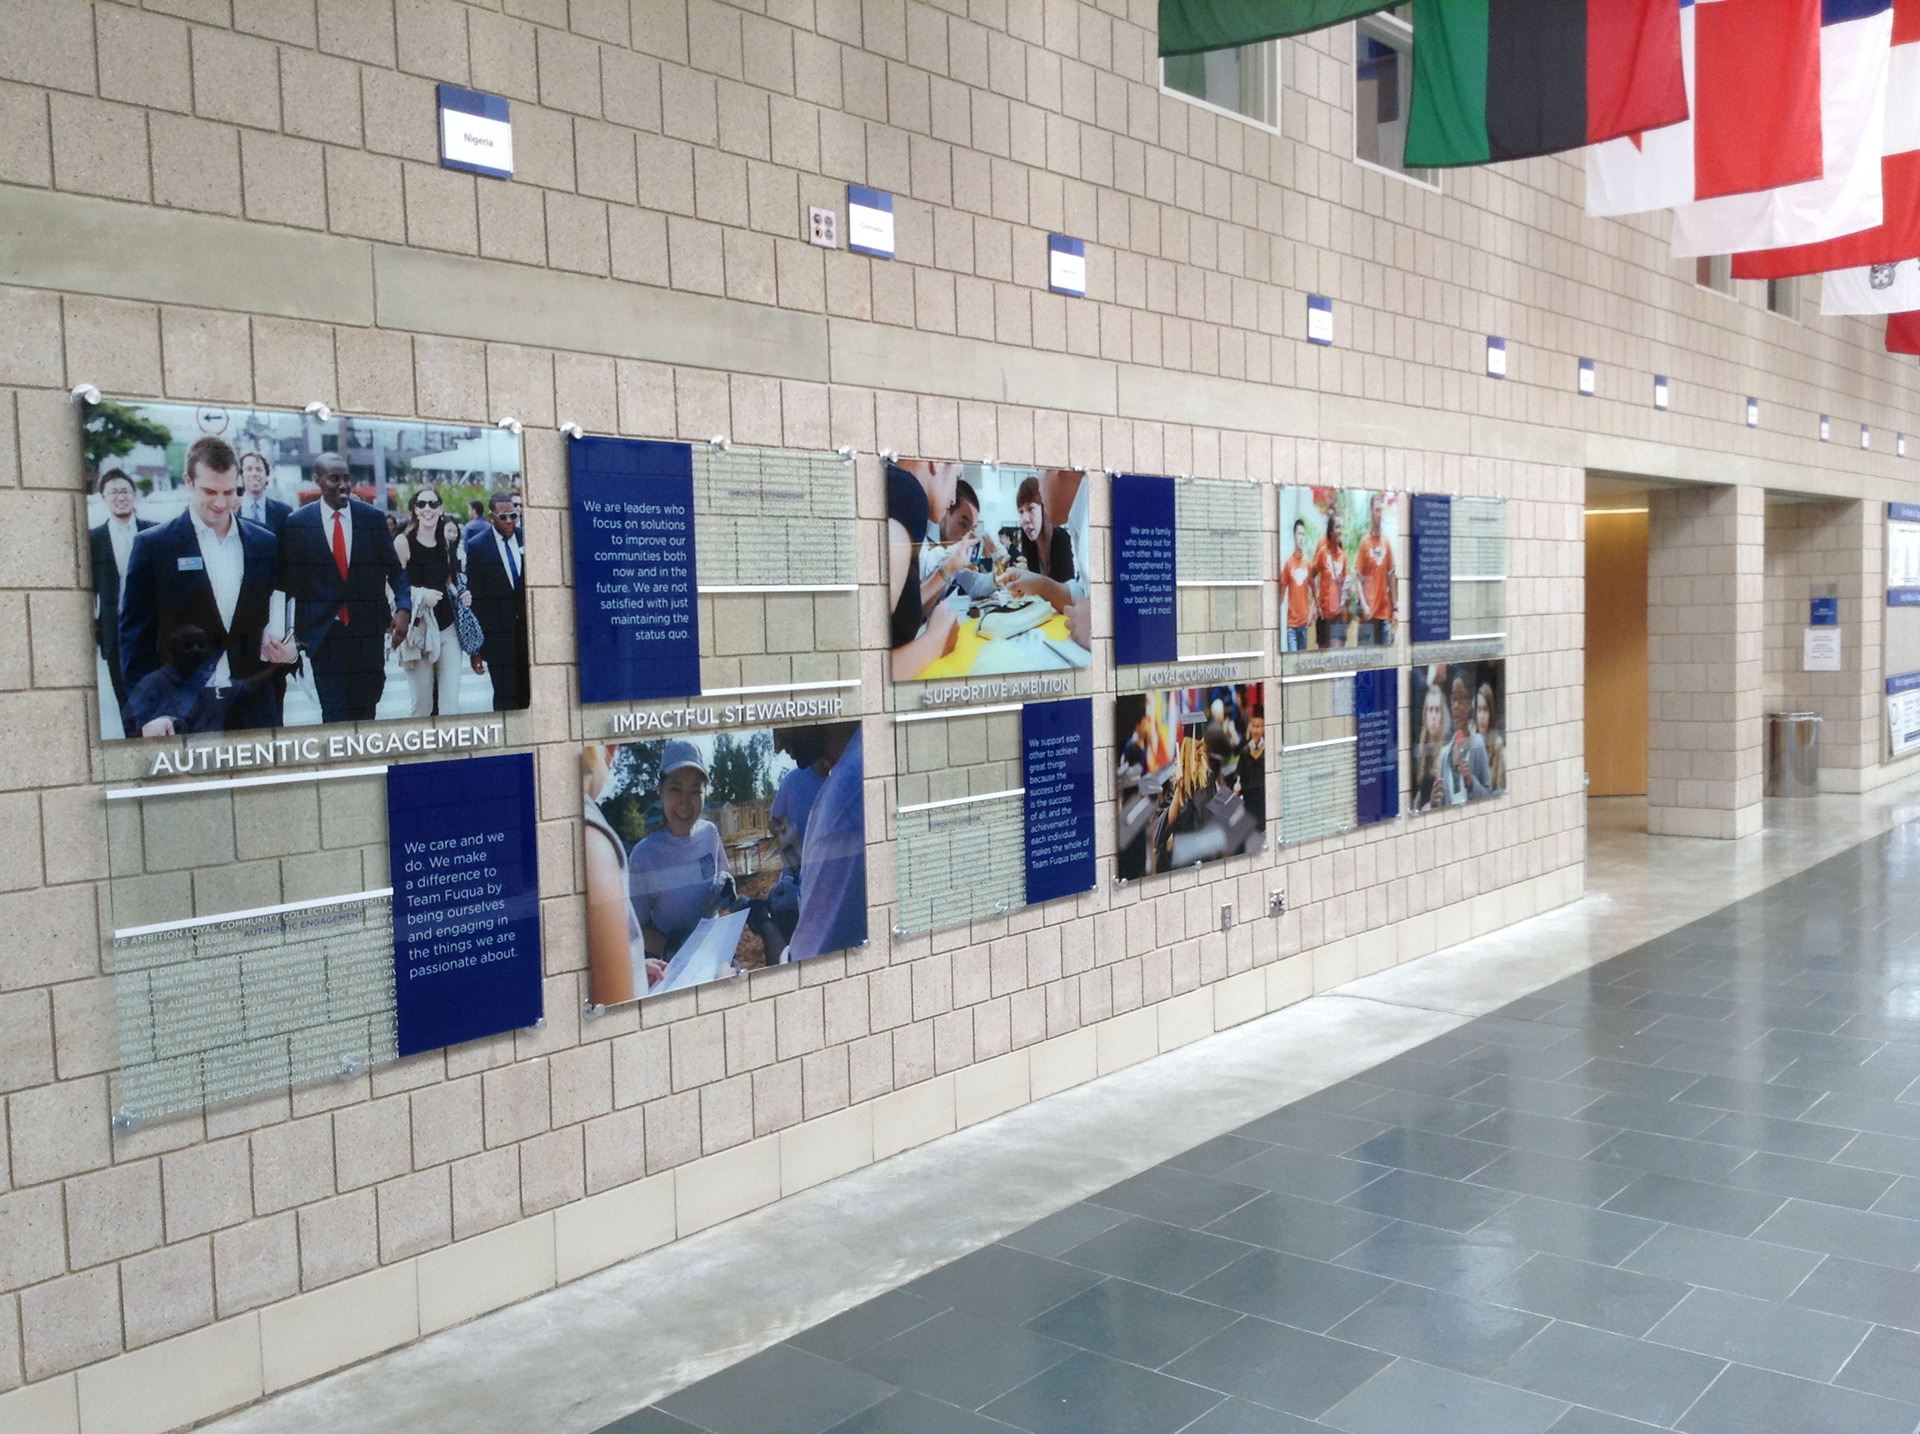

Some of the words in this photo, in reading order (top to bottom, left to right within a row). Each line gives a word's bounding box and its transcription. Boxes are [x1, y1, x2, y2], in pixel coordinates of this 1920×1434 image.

[463, 133, 494, 147] Nigeria
[584, 501, 601, 512] We
[604, 503, 620, 513] are
[624, 502, 660, 514] leaders
[664, 504, 684, 515] who
[593, 517, 622, 528] focus
[625, 519, 638, 529] on
[641, 518, 685, 530] solutions
[612, 535, 622, 544] to
[626, 535, 666, 546] improve
[670, 537, 685, 545] our
[595, 551, 661, 561] communities
[664, 551, 686, 561] both
[613, 568, 634, 577] now
[638, 566, 656, 576] and
[660, 567, 668, 576] in
[671, 567, 687, 576] the
[597, 582, 630, 593] future.
[633, 582, 649, 592] We
[653, 584, 668, 592] are
[671, 583, 687, 592] not
[601, 598, 643, 609] satisfied
[646, 598, 668, 608] with
[670, 598, 688, 610] just
[611, 615, 670, 625] maintaining
[673, 614, 689, 624] the
[636, 630, 665, 640] status
[668, 630, 689, 640] quo.
[1148, 670, 1179, 684] LOYAL
[1184, 665, 1238, 681] COMMUNITY
[924, 682, 1007, 704] SUPPORTIVE
[1012, 678, 1070, 696] AMBITION
[613, 707, 719, 732] IMPACTFUL
[723, 698, 843, 723] STEWARDSHIP
[1029, 739, 1039, 747] We
[1041, 737, 1064, 747] support
[1066, 734, 1080, 743] each
[152, 737, 320, 775] AUTHENTIC
[329, 724, 503, 758] ENGAGEMENT
[1029, 750, 1045, 760] other
[1048, 748, 1054, 756] to
[1056, 746, 1078, 756] achieve
[1029, 763, 1046, 773] great
[1048, 759, 1066, 770] things
[1030, 773, 1055, 784] because
[1057, 772, 1066, 780] the
[1030, 785, 1054, 796] success
[1055, 784, 1061, 792] of
[1063, 783, 1074, 791] one
[1030, 800, 1035, 808] is
[1037, 798, 1047, 807] the
[1048, 795, 1071, 804] success
[1031, 811, 1037, 821] of
[1049, 808, 1060, 817] and
[1062, 806, 1072, 814] the
[1031, 818, 1069, 833] achievement
[1070, 817, 1077, 825] of
[405, 842, 425, 854] We
[430, 838, 456, 851] care
[460, 833, 483, 847] and
[487, 832, 504, 842] we
[1031, 835, 1046, 845] each
[1048, 829, 1076, 842] individual
[1031, 845, 1051, 857] makes
[1053, 844, 1063, 853] the
[1064, 840, 1081, 850] whole
[1083, 837, 1089, 846] of
[405, 860, 425, 872] do.
[430, 856, 450, 868] We
[454, 851, 487, 864] make
[1032, 858, 1048, 869] Team
[1050, 854, 1069, 867] Fuqua
[406, 880, 413, 890] a
[418, 870, 480, 888] difference
[484, 867, 496, 877] to
[407, 893, 440, 907] Team
[445, 886, 483, 901] Fuqua
[488, 883, 502, 895] by
[131, 930, 182, 945] AMBITION
[186, 923, 217, 936] LOYAL
[221, 914, 280, 930] COMMUNITY
[283, 905, 339, 920] COLLECTIVE
[342, 896, 388, 910] DIVERSITY
[408, 909, 443, 925] being
[448, 900, 505, 918] ourselves
[188, 931, 240, 947] INTEGRITY
[244, 922, 297, 937] AUTHENTIC
[301, 911, 363, 928] ENGAGEMENT
[408, 929, 432, 943] and
[436, 918, 493, 937] engaging
[498, 915, 508, 926] in
[186, 942, 247, 959] SUPPORTIVE
[333, 917, 388, 933] COMMUNITY
[409, 949, 429, 960] the
[433, 939, 472, 955] things
[476, 936, 493, 947] we
[497, 932, 515, 943] are
[183, 967, 237, 982] IMPACTFUL
[313, 943, 368, 960] SUPPORTIVE
[409, 955, 477, 979] passionate
[480, 947, 518, 963] about.
[149, 982, 211, 999] COMMUNITY
[215, 969, 274, 987] COLLECTIVE
[278, 961, 325, 974] DIVERSITY
[326, 973, 380, 989] COLLECTIVE
[169, 992, 225, 1008] AUTHENTIC
[295, 990, 346, 1006] AUTHENTIC
[250, 1008, 309, 1026] SUPPORTIVE
[312, 998, 356, 1013] AMBITION
[359, 992, 387, 1003] LOYAL
[193, 1060, 225, 1073] LOYAL
[289, 1034, 345, 1051] COLLECTIVE
[349, 1022, 394, 1037] DIVERSITY
[195, 1065, 247, 1083] INTEGRITY
[250, 1053, 304, 1071] AUTHENTIC
[307, 1057, 336, 1069] LOYAL
[167, 1095, 220, 1113] DIVERSITY
[222, 1073, 312, 1100] UNCOMPROMISING
